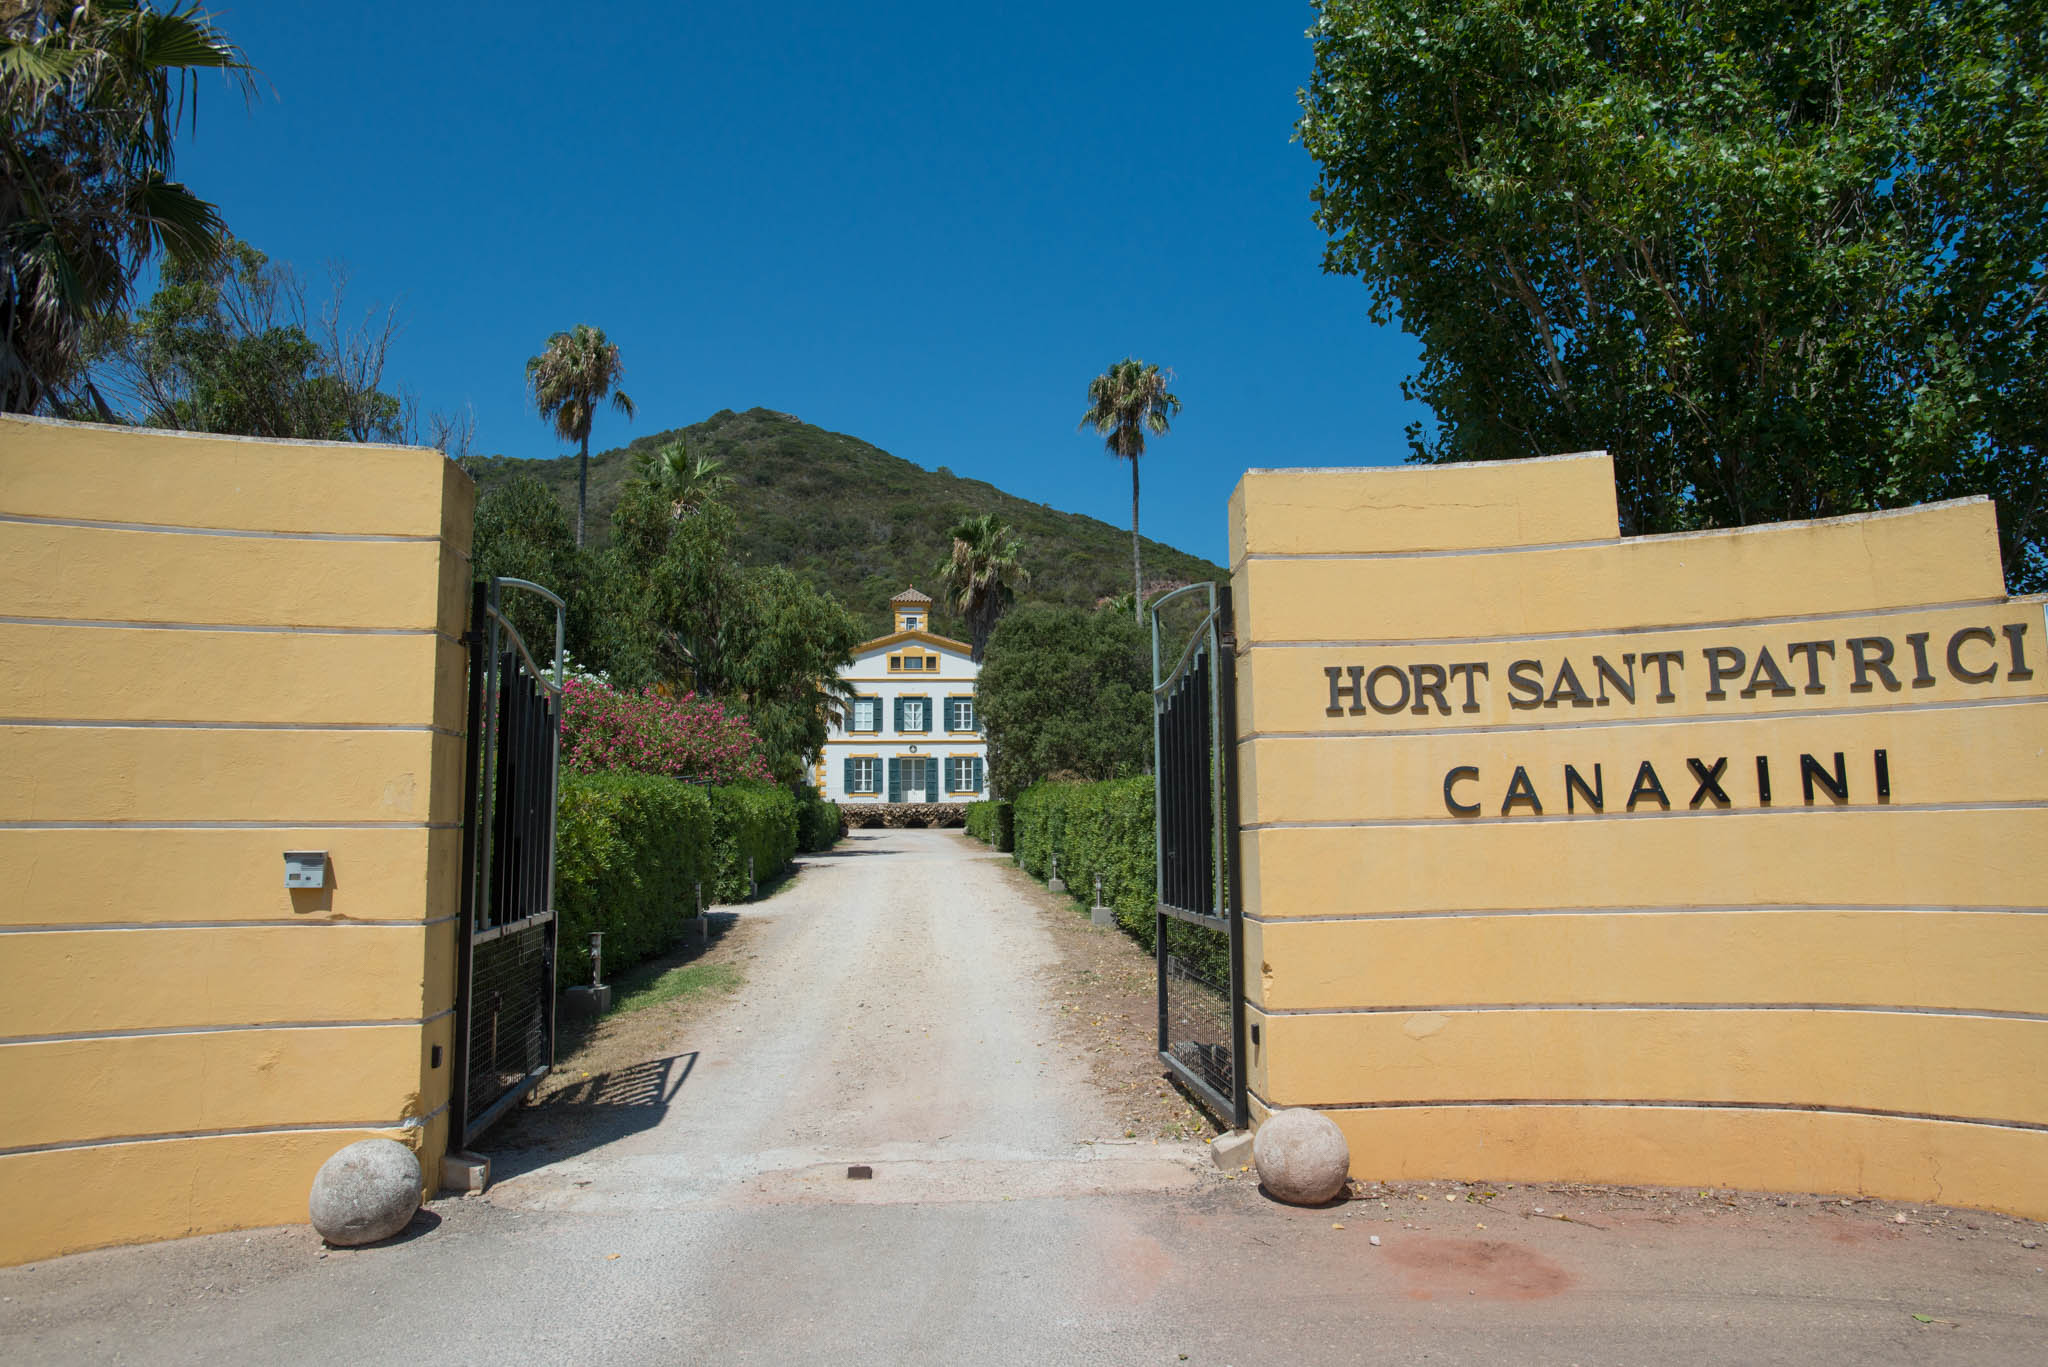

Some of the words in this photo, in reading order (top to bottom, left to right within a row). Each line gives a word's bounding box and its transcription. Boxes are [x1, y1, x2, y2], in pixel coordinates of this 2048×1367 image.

[1324, 662, 1489, 717] HORT
[1508, 650, 1685, 708] SANT
[1702, 623, 2034, 700] PATRICI
[1444, 749, 1891, 816] CANAXINI
